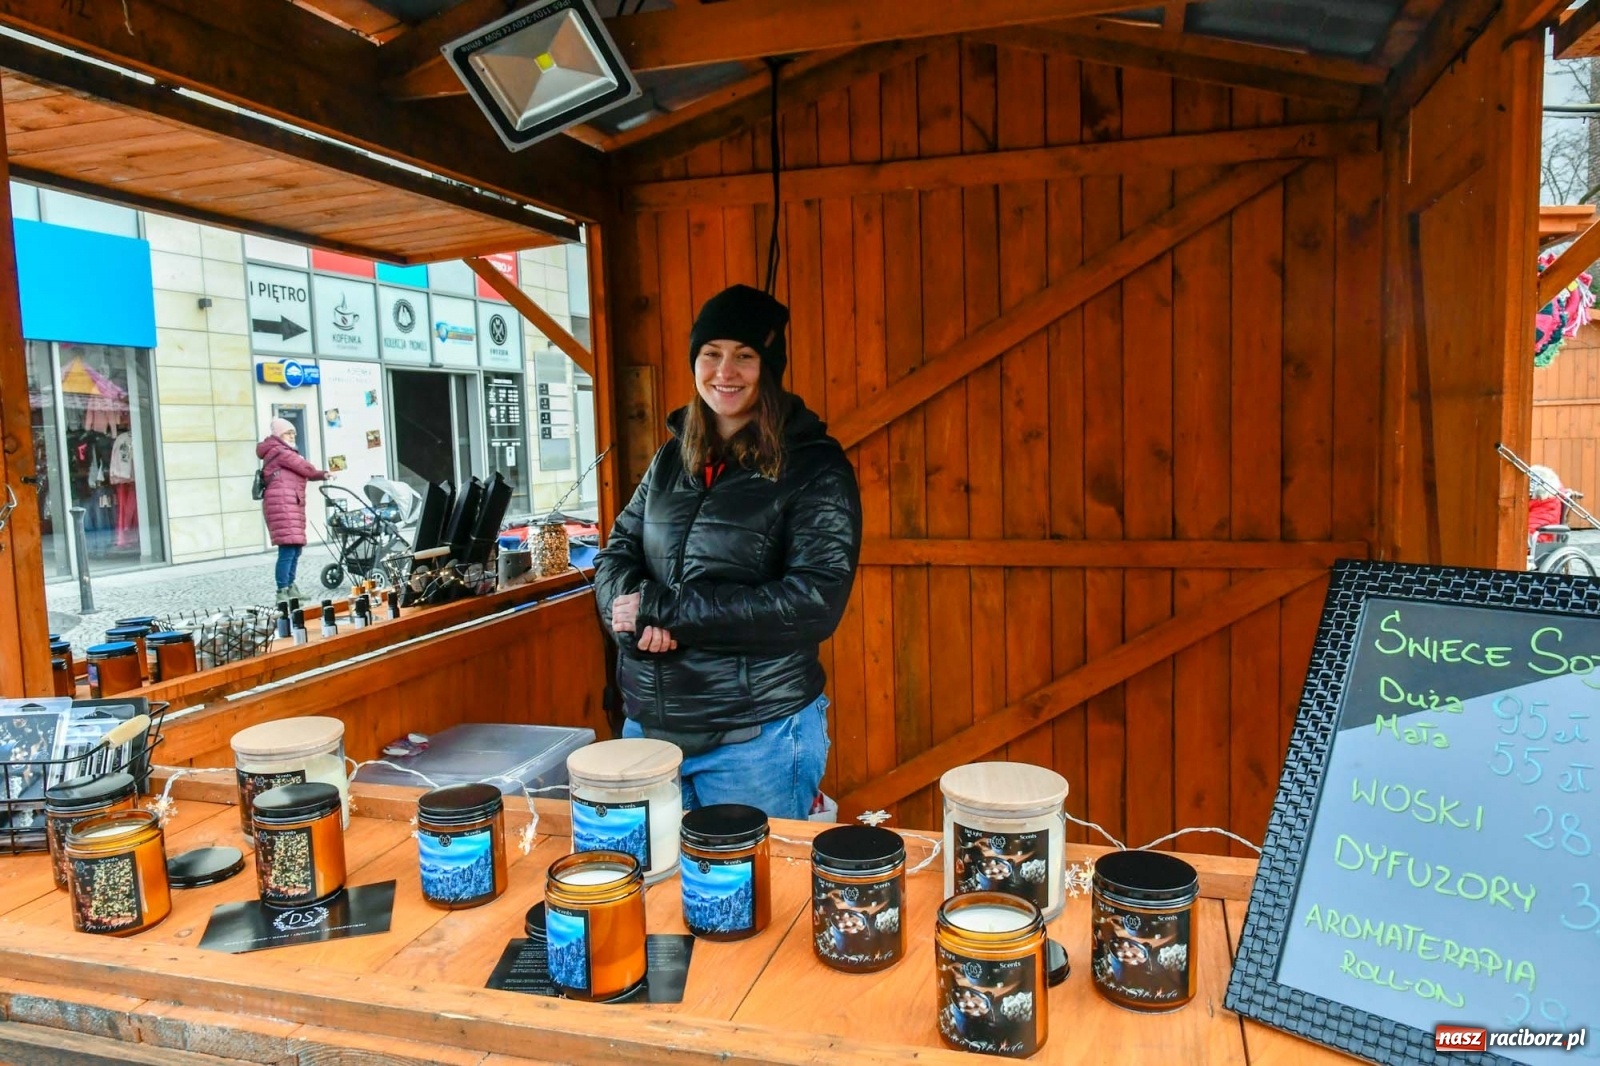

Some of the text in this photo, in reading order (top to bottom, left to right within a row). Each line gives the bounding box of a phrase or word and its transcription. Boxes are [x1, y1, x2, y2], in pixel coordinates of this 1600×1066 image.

[258, 282, 307, 303] PIĘTRO
[1379, 676, 1465, 714] Duża
[1492, 695, 1549, 740] 95
[1487, 741, 1550, 785] 55
[1351, 778, 1592, 858] WOSKI 28
[1334, 833, 1537, 913] DYFUZORY
[288, 910, 316, 926] DS
[1304, 903, 1537, 992] AROMATERAPIA
[999, 960, 1022, 970] Scents
[1339, 949, 1465, 1009] ROLL-ON
